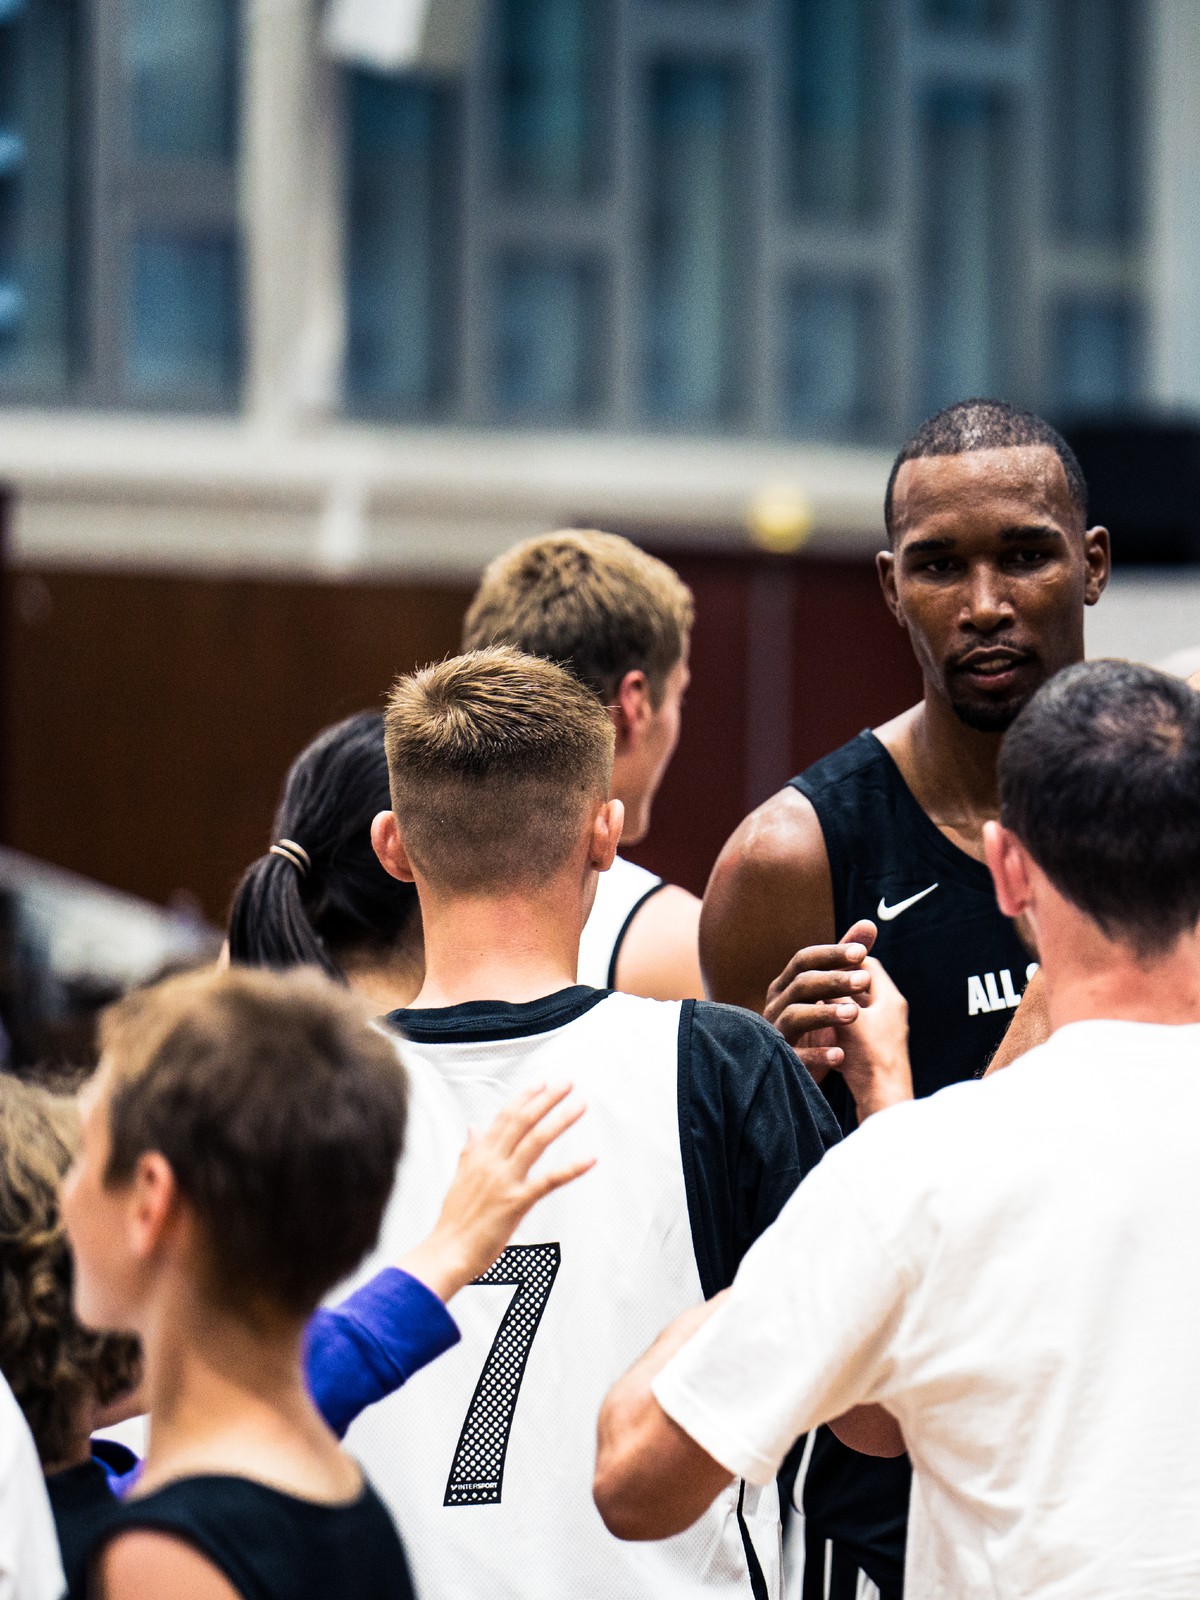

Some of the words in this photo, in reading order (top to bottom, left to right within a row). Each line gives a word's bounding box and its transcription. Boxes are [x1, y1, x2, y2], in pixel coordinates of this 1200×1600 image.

[967, 969, 1021, 1016] ALL
[443, 1241, 561, 1506] 7
[457, 1482, 498, 1490] INTERSPORT
